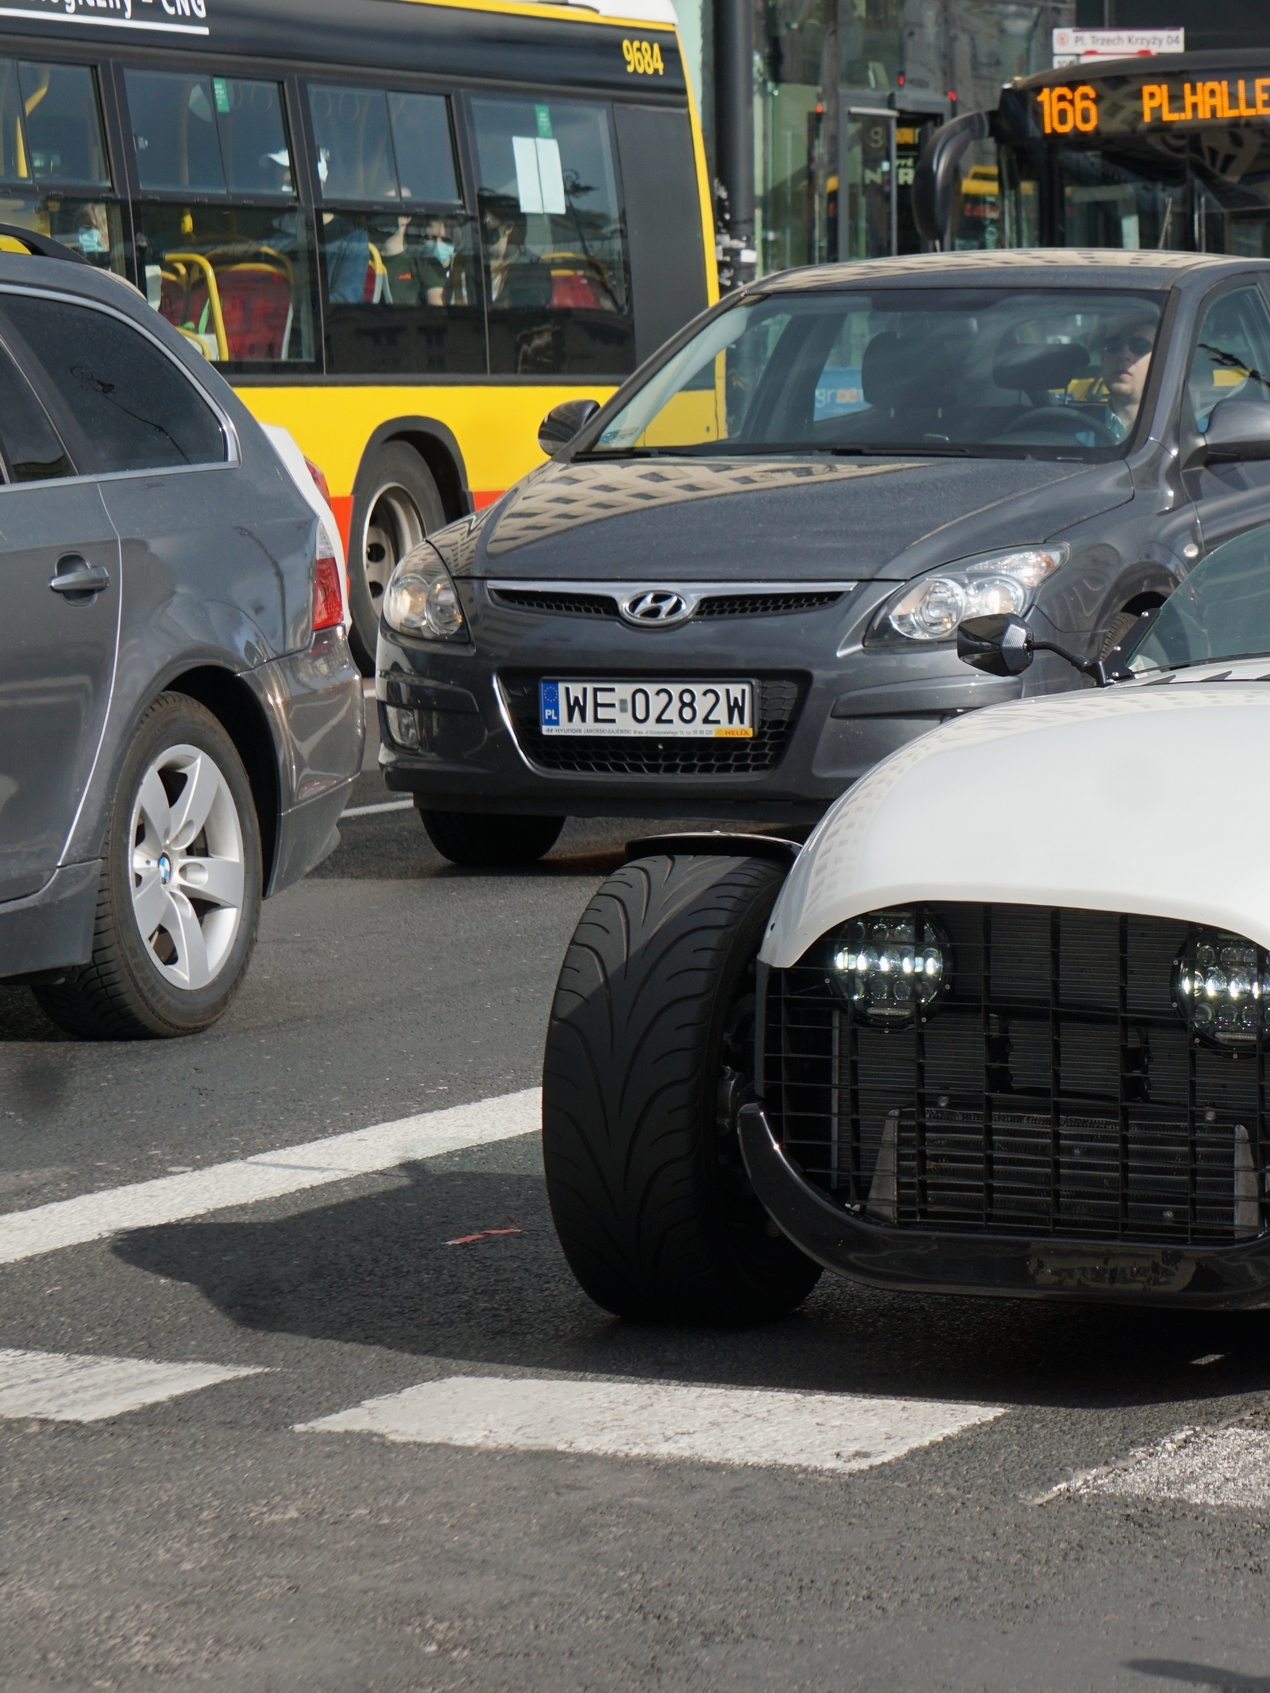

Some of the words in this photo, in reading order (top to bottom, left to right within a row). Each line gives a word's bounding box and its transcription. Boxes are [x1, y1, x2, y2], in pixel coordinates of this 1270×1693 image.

[1090, 35, 1124, 47] Trzech
[1127, 35, 1164, 49] Krzyży
[622, 39, 664, 75] 9684
[1037, 86, 1098, 134] 166
[544, 708, 558, 720] PL
[564, 686, 617, 724] WE
[631, 687, 747, 726] 0282W
[724, 729, 750, 737] HELIX
